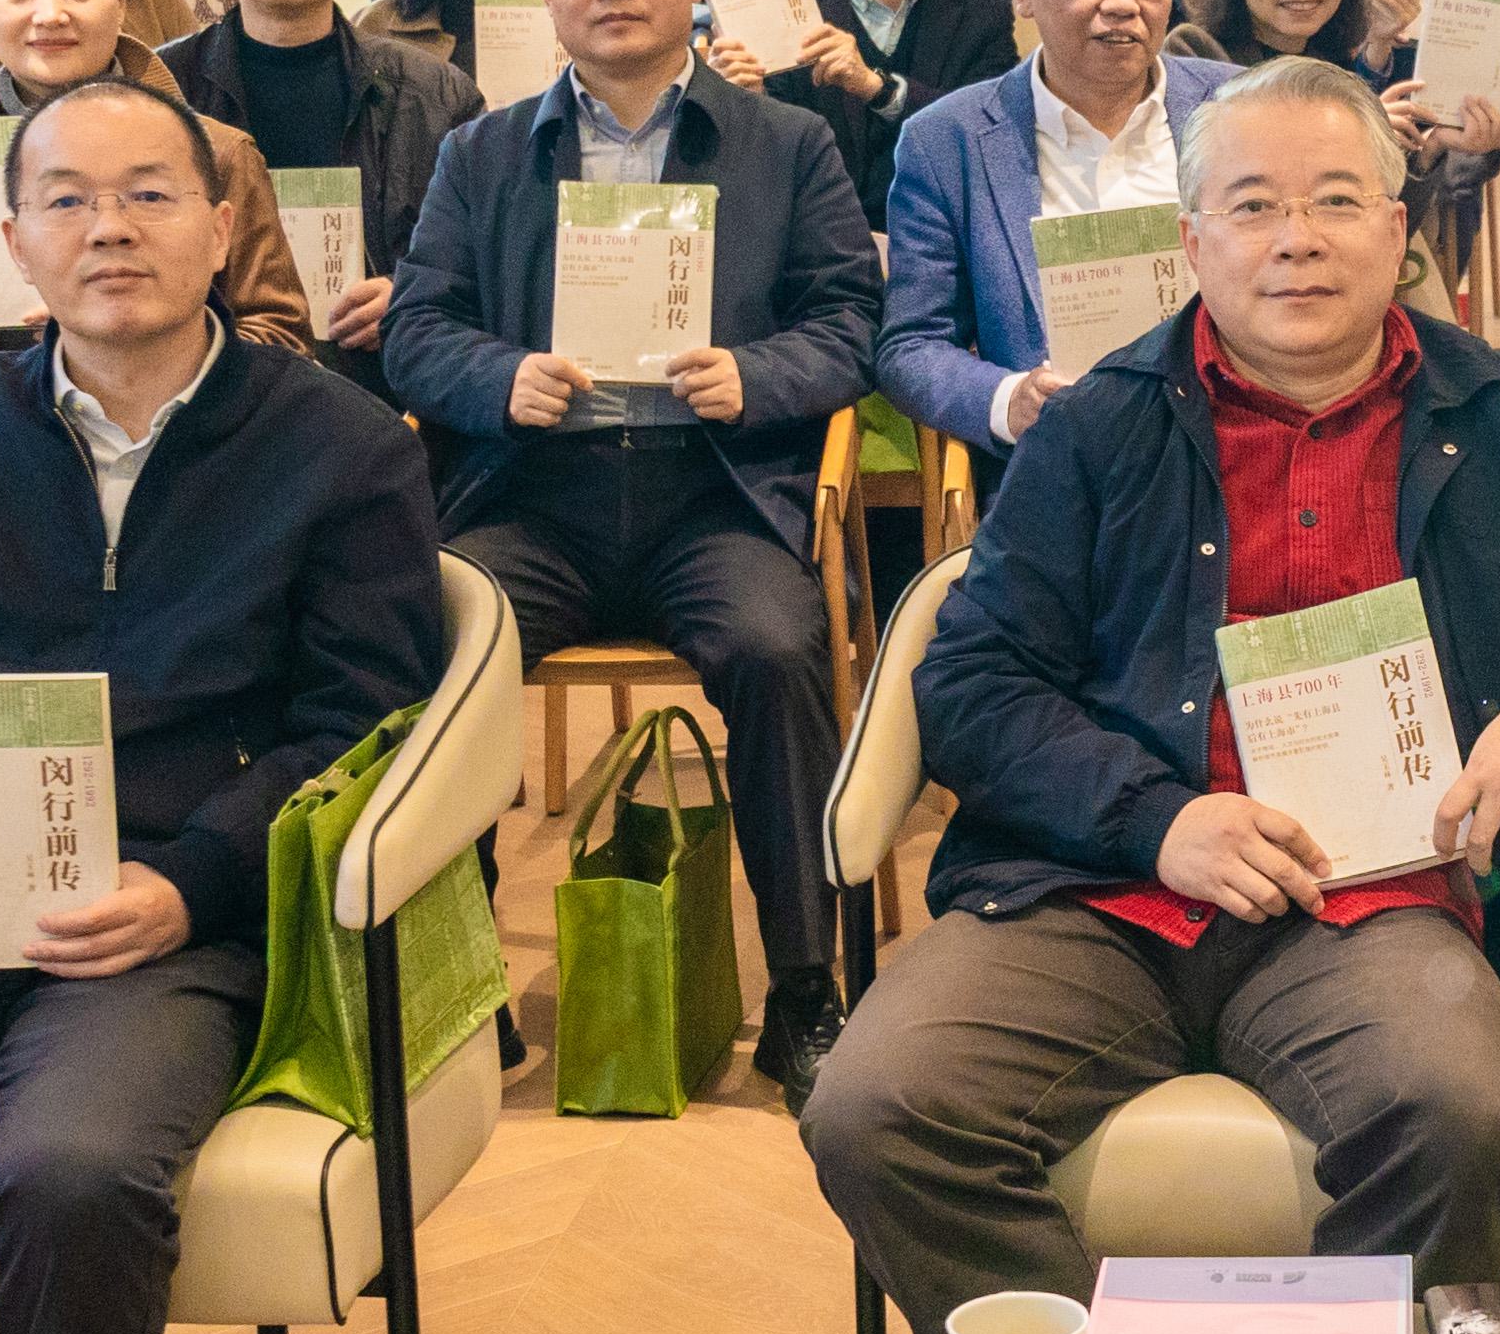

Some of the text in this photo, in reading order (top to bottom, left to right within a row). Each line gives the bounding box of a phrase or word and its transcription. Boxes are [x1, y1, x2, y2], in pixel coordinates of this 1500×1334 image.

[321, 212, 345, 296] 闵行前传
[562, 234, 641, 246] 上海县700年
[1050, 266, 1124, 285] 上海县700年
[666, 235, 692, 331] 闵行前传
[1240, 672, 1343, 708] 上海县700年
[1379, 654, 1431, 786] 闵行前传
[40, 756, 80, 891] 闵行前传
